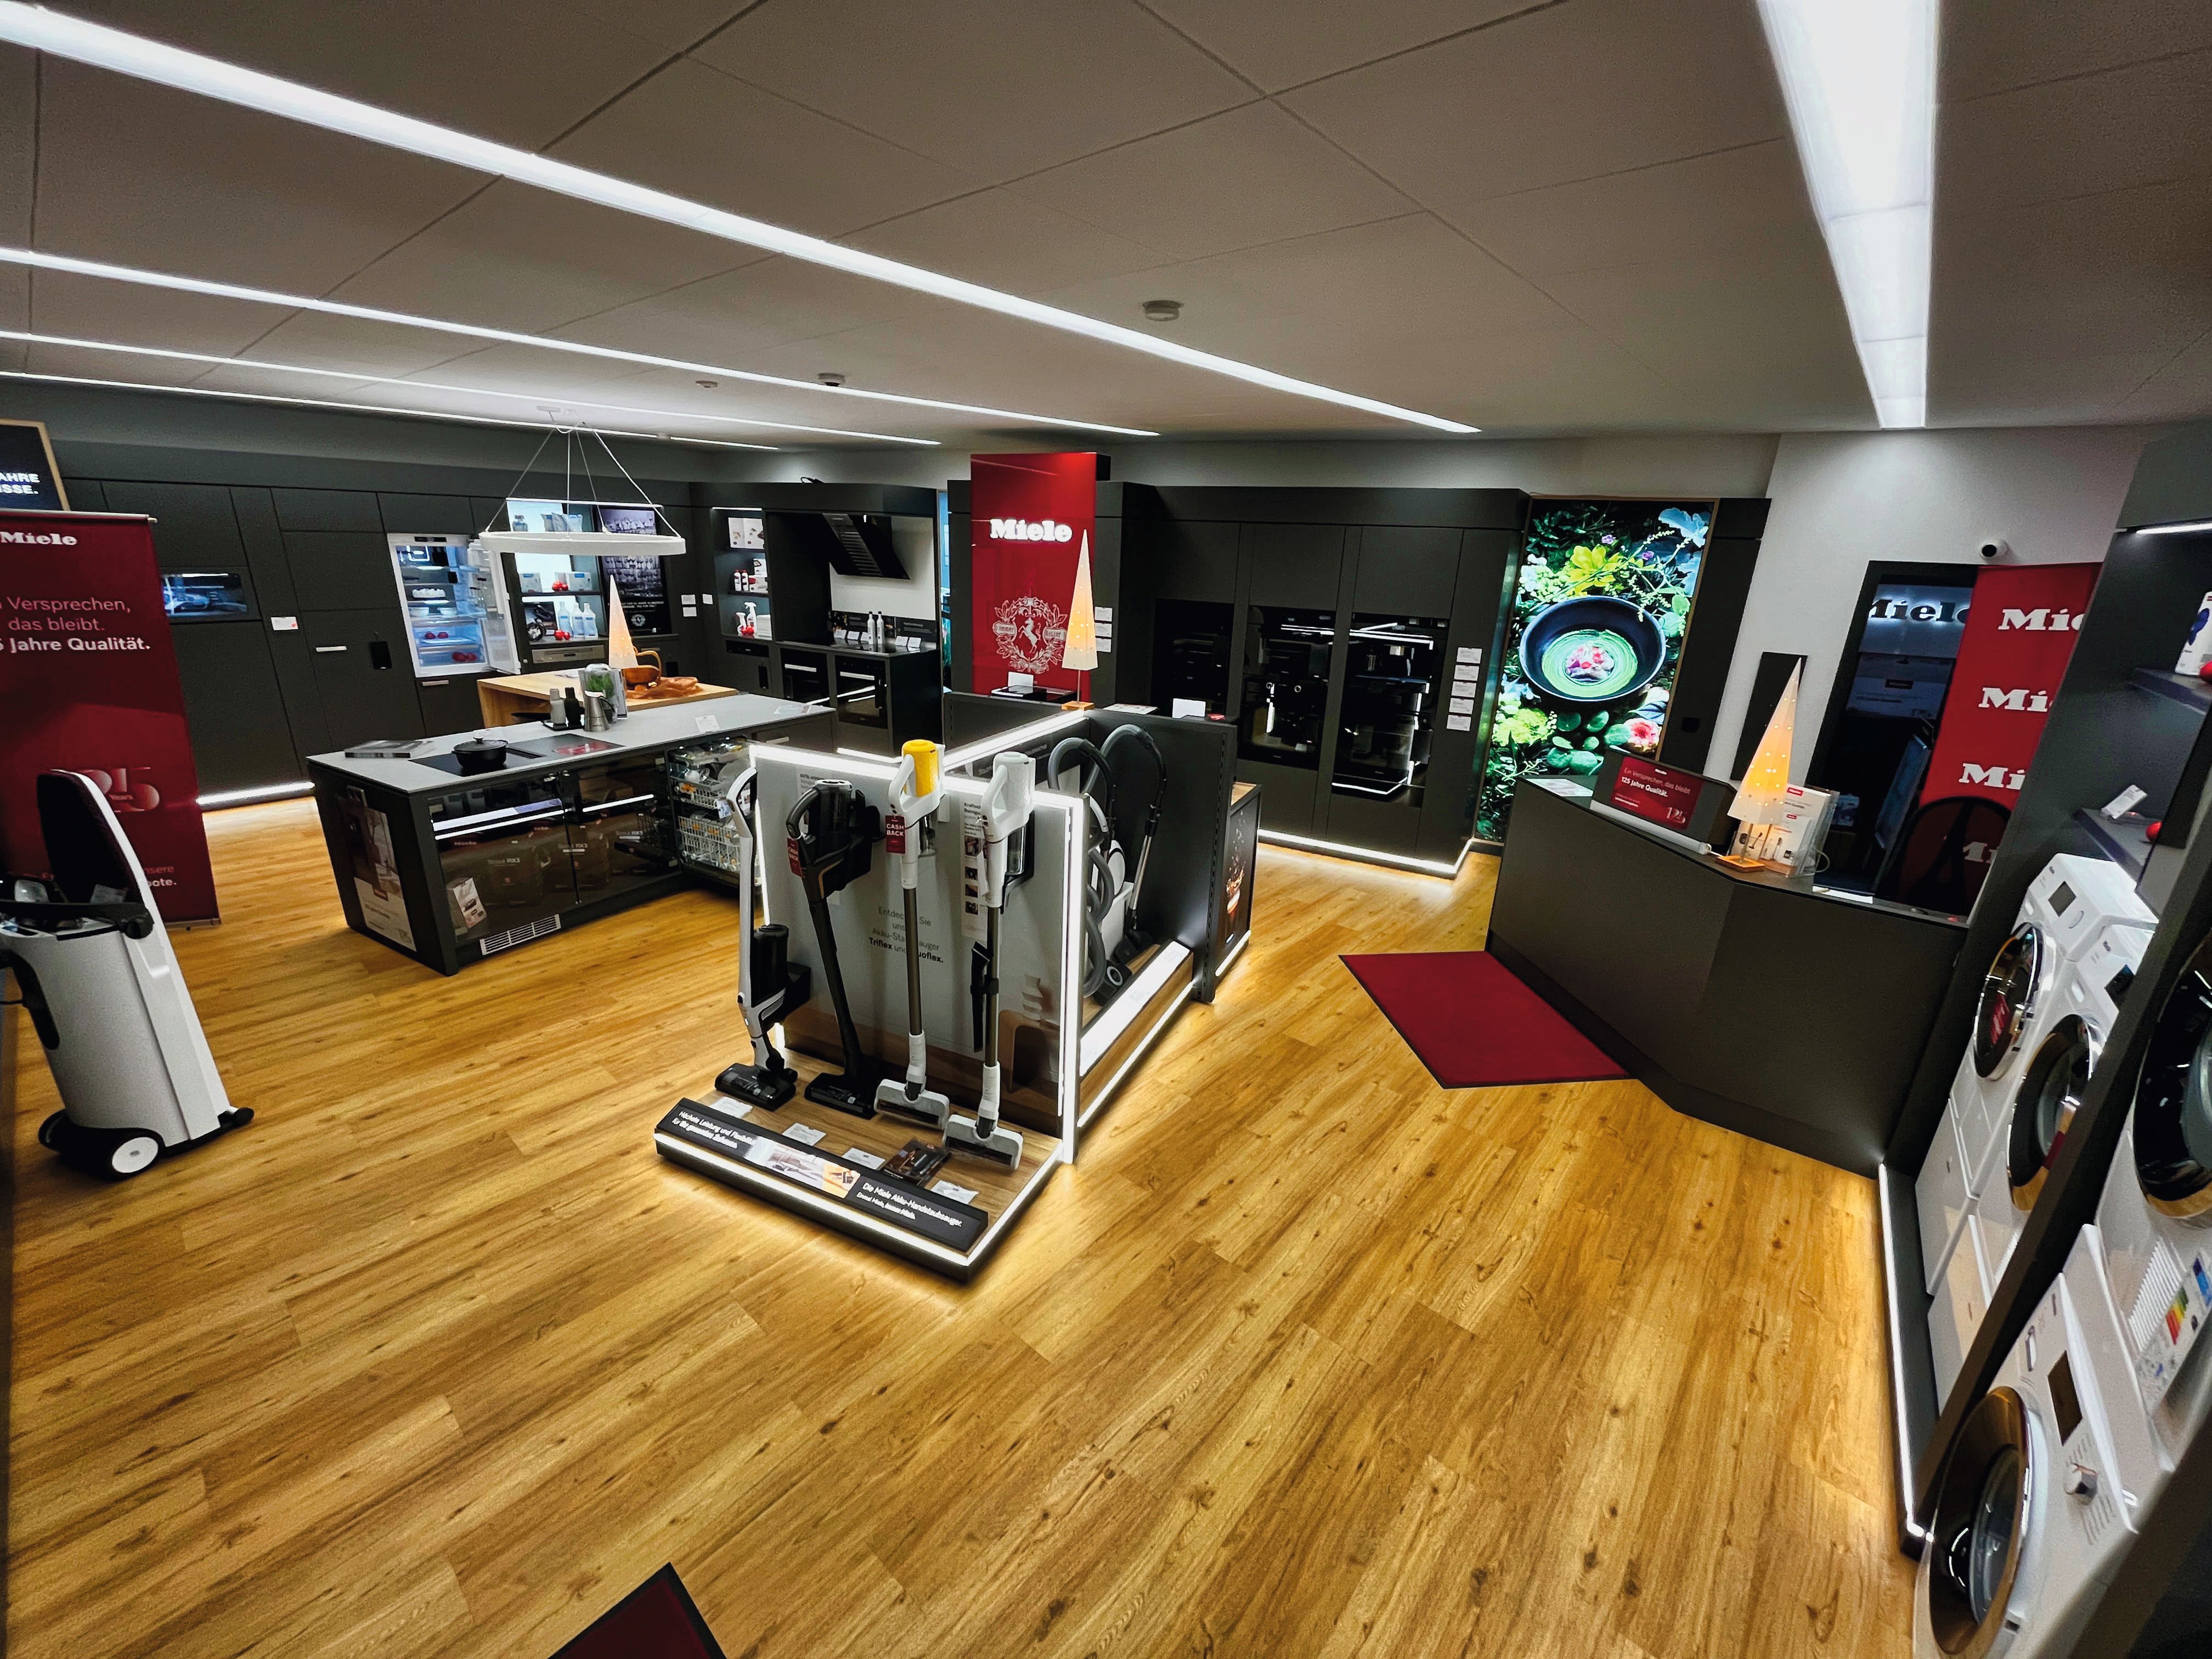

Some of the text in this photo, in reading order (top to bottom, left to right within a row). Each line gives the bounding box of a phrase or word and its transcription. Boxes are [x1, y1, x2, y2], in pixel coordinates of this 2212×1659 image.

[990, 518, 1073, 542] Miele
[0, 531, 77, 545] Miele
[7, 596, 131, 613] Versprechen,
[8, 617, 106, 631] das bleibt.
[10, 637, 62, 653] Jahre
[67, 637, 151, 651] Qualität.
[145, 865, 174, 874] nsere
[878, 906, 932, 927] Entdec Sie
[868, 936, 893, 950] Triflex
